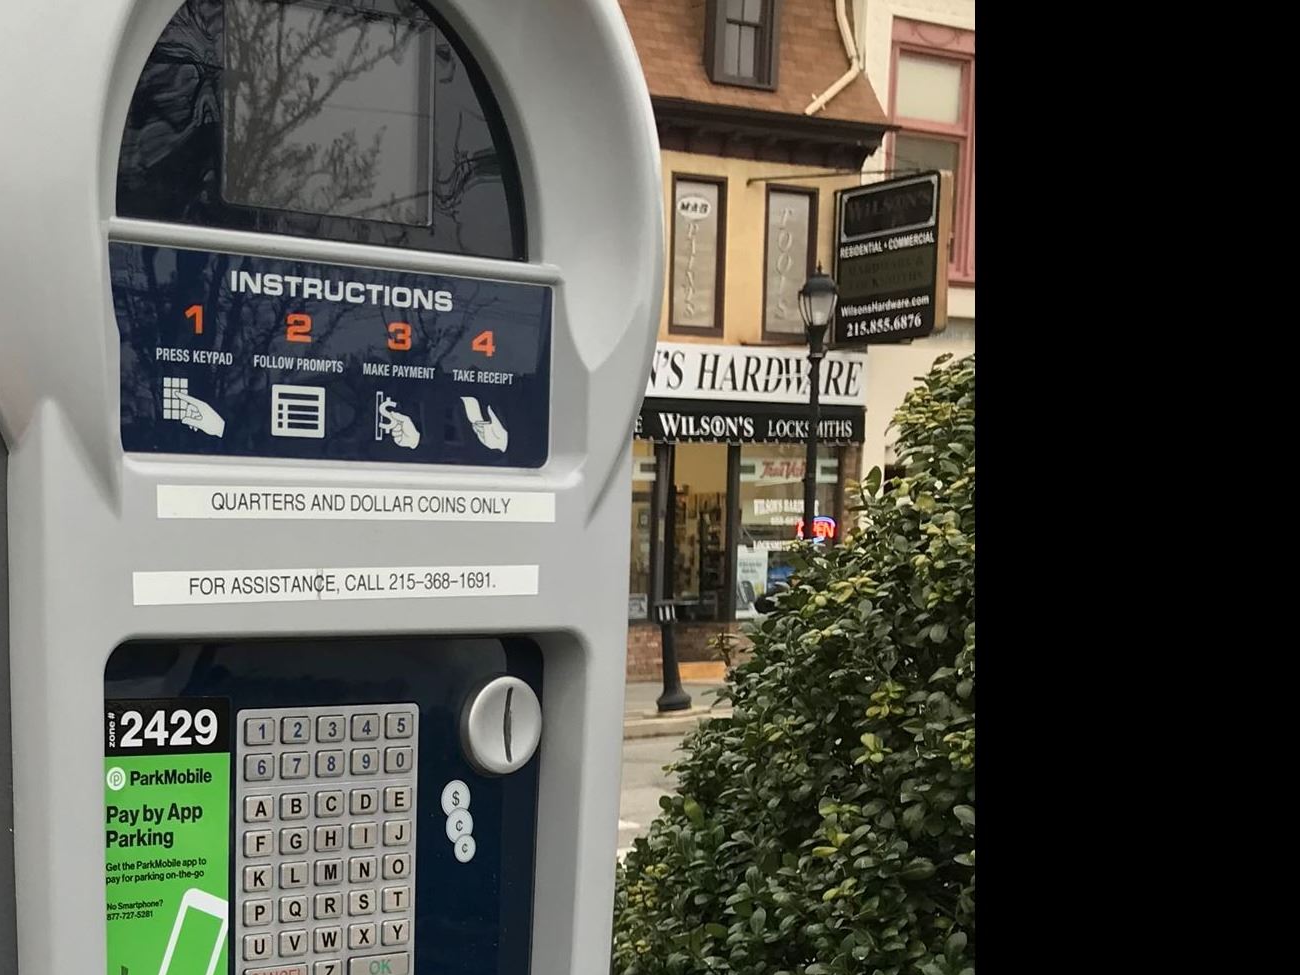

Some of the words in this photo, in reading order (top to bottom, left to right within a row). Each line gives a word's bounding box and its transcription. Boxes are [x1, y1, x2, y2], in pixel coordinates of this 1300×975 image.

[840, 240, 883, 259] RESIDENTIAL
[888, 232, 935, 251] COMMERCIAL
[230, 270, 453, 313] INSTRUCTIONS
[185, 305, 204, 334] 1
[285, 313, 312, 343] 2
[388, 322, 412, 351] 3
[472, 331, 495, 357] 4
[155, 347, 191, 363] PRESS
[192, 349, 233, 366] KEYPAD
[253, 354, 294, 370] FOLLOW
[297, 357, 344, 374] PROMPTS
[362, 363, 390, 377] MAKE
[392, 364, 435, 381] PAYMENT
[452, 368, 476, 383] TAKE
[478, 370, 514, 386] RECEIPT
[659, 413, 755, 437] WILSON'S
[211, 492, 307, 513] QUARTERS
[310, 493, 346, 512] AND
[350, 494, 414, 513] DOLLAR
[418, 495, 466, 514] COINS
[471, 497, 511, 515] ONLY
[189, 576, 226, 595] FOR
[230, 573, 341, 595] ASSISTANCE,
[345, 573, 384, 592] CALL
[120, 709, 218, 747] 2429
[259, 724, 265, 739] 1
[294, 722, 302, 738] 2
[328, 722, 337, 737] 3
[362, 720, 371, 736] 4
[397, 718, 405, 733] 5
[257, 760, 266, 775] 6
[293, 758, 301, 774] 7
[328, 756, 335, 771] 8
[362, 754, 370, 769] 9
[130, 768, 212, 786] ParkMobile
[106, 806, 139, 826] Pay
[143, 804, 164, 825] by
[168, 803, 203, 823] App
[255, 801, 267, 817] A
[291, 799, 302, 814] B
[326, 796, 337, 811] C
[361, 794, 371, 809] D
[395, 792, 404, 807] E
[106, 828, 174, 848] Parking
[257, 836, 265, 851] F
[290, 834, 301, 848] G
[325, 831, 336, 846] H
[395, 825, 403, 840] J
[106, 863, 121, 872] Get
[122, 861, 135, 870] the
[137, 859, 181, 870] ParkMobile
[182, 859, 197, 868] app
[254, 871, 265, 886] K
[291, 868, 300, 883] L
[325, 864, 337, 879] M
[360, 862, 370, 877] N
[106, 875, 121, 885] pay
[121, 873, 133, 882] for
[135, 871, 164, 882] parking
[166, 870, 204, 880] on-the-go
[255, 905, 265, 921] P
[289, 902, 301, 917] Q
[325, 898, 335, 913] R
[359, 894, 369, 909] S
[393, 892, 402, 906] T
[254, 939, 264, 954] U
[290, 936, 300, 951] V
[322, 932, 337, 947] W
[359, 929, 369, 944] X
[393, 924, 402, 940] Y
[369, 959, 392, 975] OK
